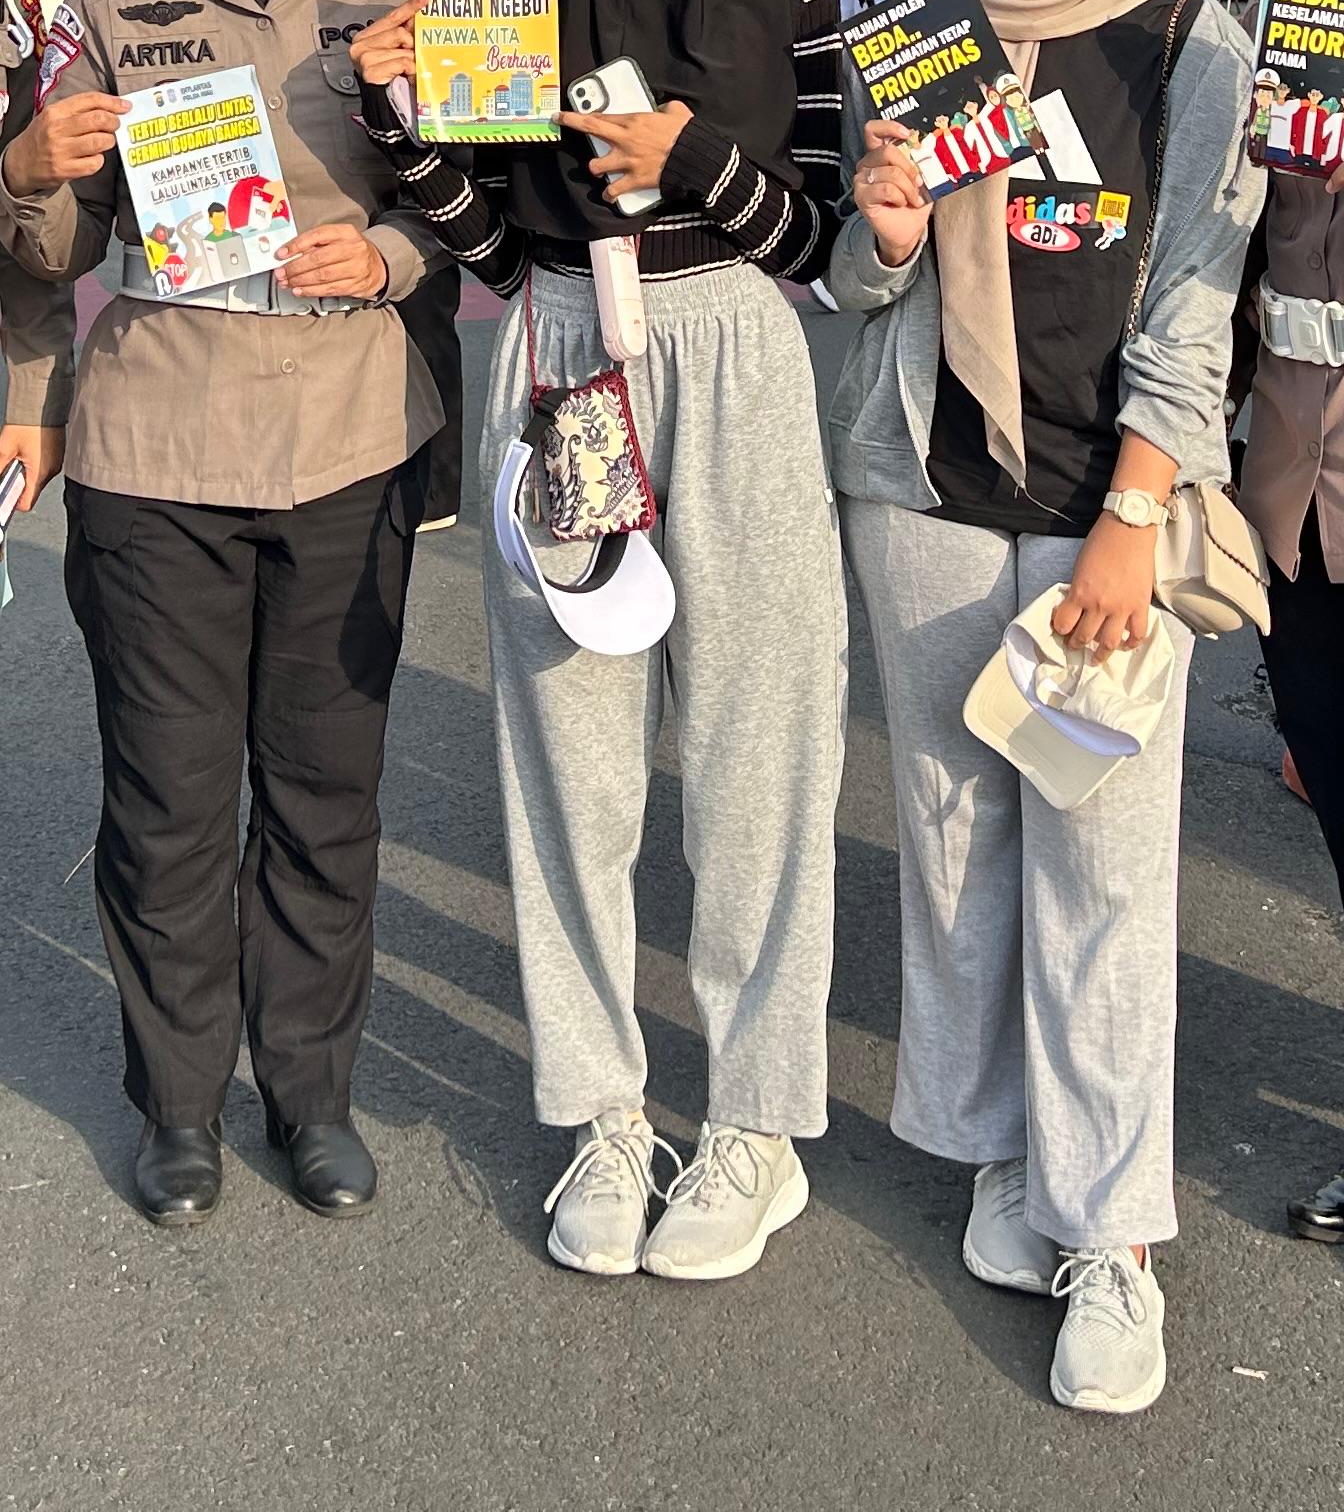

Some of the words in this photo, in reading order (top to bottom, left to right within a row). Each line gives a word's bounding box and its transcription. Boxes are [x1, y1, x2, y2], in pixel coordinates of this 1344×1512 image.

[319, 19, 374, 49] PO
[422, 28, 480, 46] NYAWA
[485, 27, 521, 45] KITA
[843, 12, 890, 45] PILIHAN
[118, 38, 216, 69] ARTIKA
[486, 44, 553, 78] Berharga
[861, 35, 940, 84] KESELAMATAN
[937, 18, 972, 45] TETAP
[1265, 49, 1308, 71] UTAMA
[869, 38, 982, 109] PRIORITAS
[128, 116, 168, 144] TERTIB
[167, 104, 217, 133] BERLALU
[216, 95, 255, 121] LINTAS
[880, 95, 920, 121] UTAMA
[128, 137, 172, 168] CERMIN
[171, 127, 217, 155] BUDAYA
[215, 116, 262, 144] BANGSA
[151, 157, 212, 183] KAMPANYE
[212, 147, 252, 165] TERTIB
[150, 185, 180, 202] LALU
[181, 174, 219, 194] LINTAS
[219, 163, 259, 182] TERTIB
[166, 263, 188, 278] STOP
